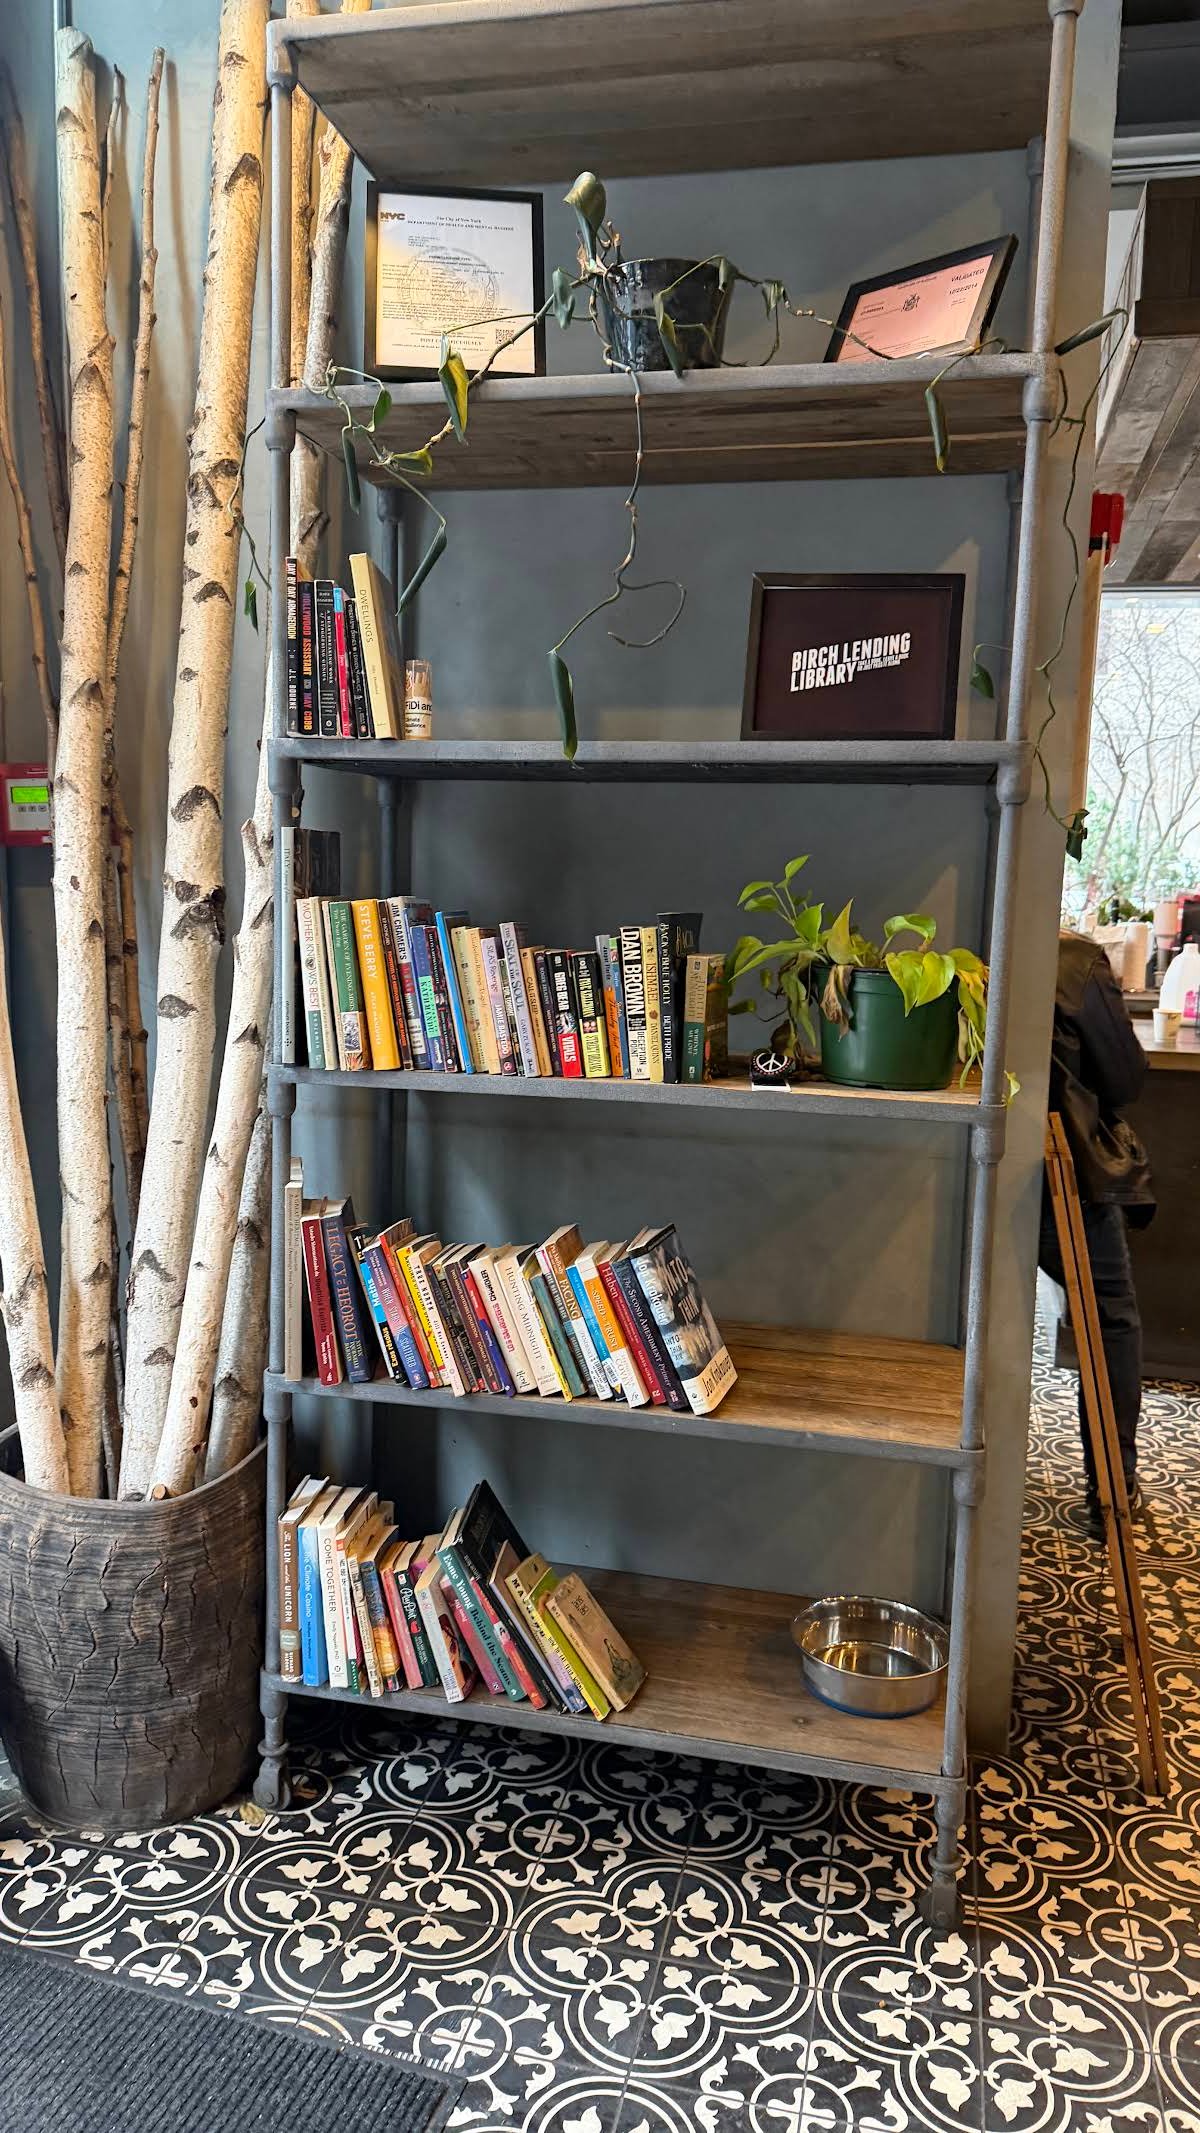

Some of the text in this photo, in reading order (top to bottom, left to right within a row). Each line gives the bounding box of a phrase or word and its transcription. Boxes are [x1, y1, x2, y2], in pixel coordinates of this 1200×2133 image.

[380, 211, 405, 221] NYC
[287, 564, 295, 575] DAY
[287, 586, 295, 597] DAY
[287, 598, 296, 639] ARMAGEDDON
[302, 593, 311, 675] HOLLYWOOD ASSISTANT
[359, 588, 375, 644] DWELLINGS
[792, 644, 839, 672] BIRCH
[843, 632, 911, 664] LENDING
[790, 661, 858, 692] LIBRARY
[288, 684, 296, 709] BOURNE
[303, 693, 312, 730] MAY COBB
[391, 903, 401, 917] JIM
[302, 902, 314, 943] MOTHER
[309, 986, 319, 1008] BEST
[341, 923, 349, 950] GARDEN
[359, 905, 378, 980] STEVE BERRY
[394, 919, 407, 960] CRAMER'S
[344, 963, 353, 992] EVENING
[488, 966, 499, 993] Revenge
[504, 939, 518, 966] SEAT
[511, 981, 525, 1011] SOUL
[554, 971, 568, 992] GREG
[622, 931, 645, 1015] DAN BROWN
[659, 924, 672, 1005] BACK BLUE HOLLY
[347, 992, 355, 1011] MISTS
[557, 991, 570, 1011] BEAR
[646, 963, 658, 1004] ISHMAEL
[421, 981, 434, 1033] KATHMANDU
[495, 1004, 504, 1024] JAMIE
[530, 998, 538, 1015] SLEEP
[498, 1025, 509, 1055] BASTEDO
[561, 1036, 577, 1062] VITALS
[630, 1040, 638, 1058] POINT
[637, 1032, 646, 1065] DECEPTION
[650, 1023, 659, 1064] DANIEL QUINN
[663, 1016, 673, 1062] BETH PRIDE
[325, 1226, 349, 1277] LEGACY
[366, 1278, 381, 1307] Maths
[414, 1265, 434, 1312] TRUE NORTH
[480, 1269, 497, 1302] CHANDLER
[601, 1266, 622, 1299] Haben
[635, 1257, 672, 1324] Jon Krakauer
[662, 1255, 689, 1296] INTO
[336, 1285, 360, 1341] HEOROT
[505, 1267, 526, 1311] HUNTING
[520, 1312, 544, 1362] MIDNIGHT
[557, 1278, 580, 1320] FACING
[558, 1306, 568, 1320] BACK
[591, 1290, 619, 1348] SPEED TRUST
[623, 1276, 673, 1388] The SECOND AMENDMENT Primer
[399, 1337, 417, 1368] SCATTERED
[665, 1334, 680, 1346] INTO
[389, 1353, 400, 1367] Exos
[615, 1357, 632, 1388] COVEY
[701, 1354, 732, 1397] Jon Krakauer
[304, 1551, 313, 1618] The Climate Casino
[324, 1538, 336, 1612] COME TOGETHER
[284, 1586, 292, 1622] UNICORN
[442, 1554, 461, 1580] Esme
[453, 1579, 476, 1610] Young
[470, 1608, 492, 1641] Behind
[486, 1640, 499, 1656] the
[494, 1656, 514, 1686] Seams
